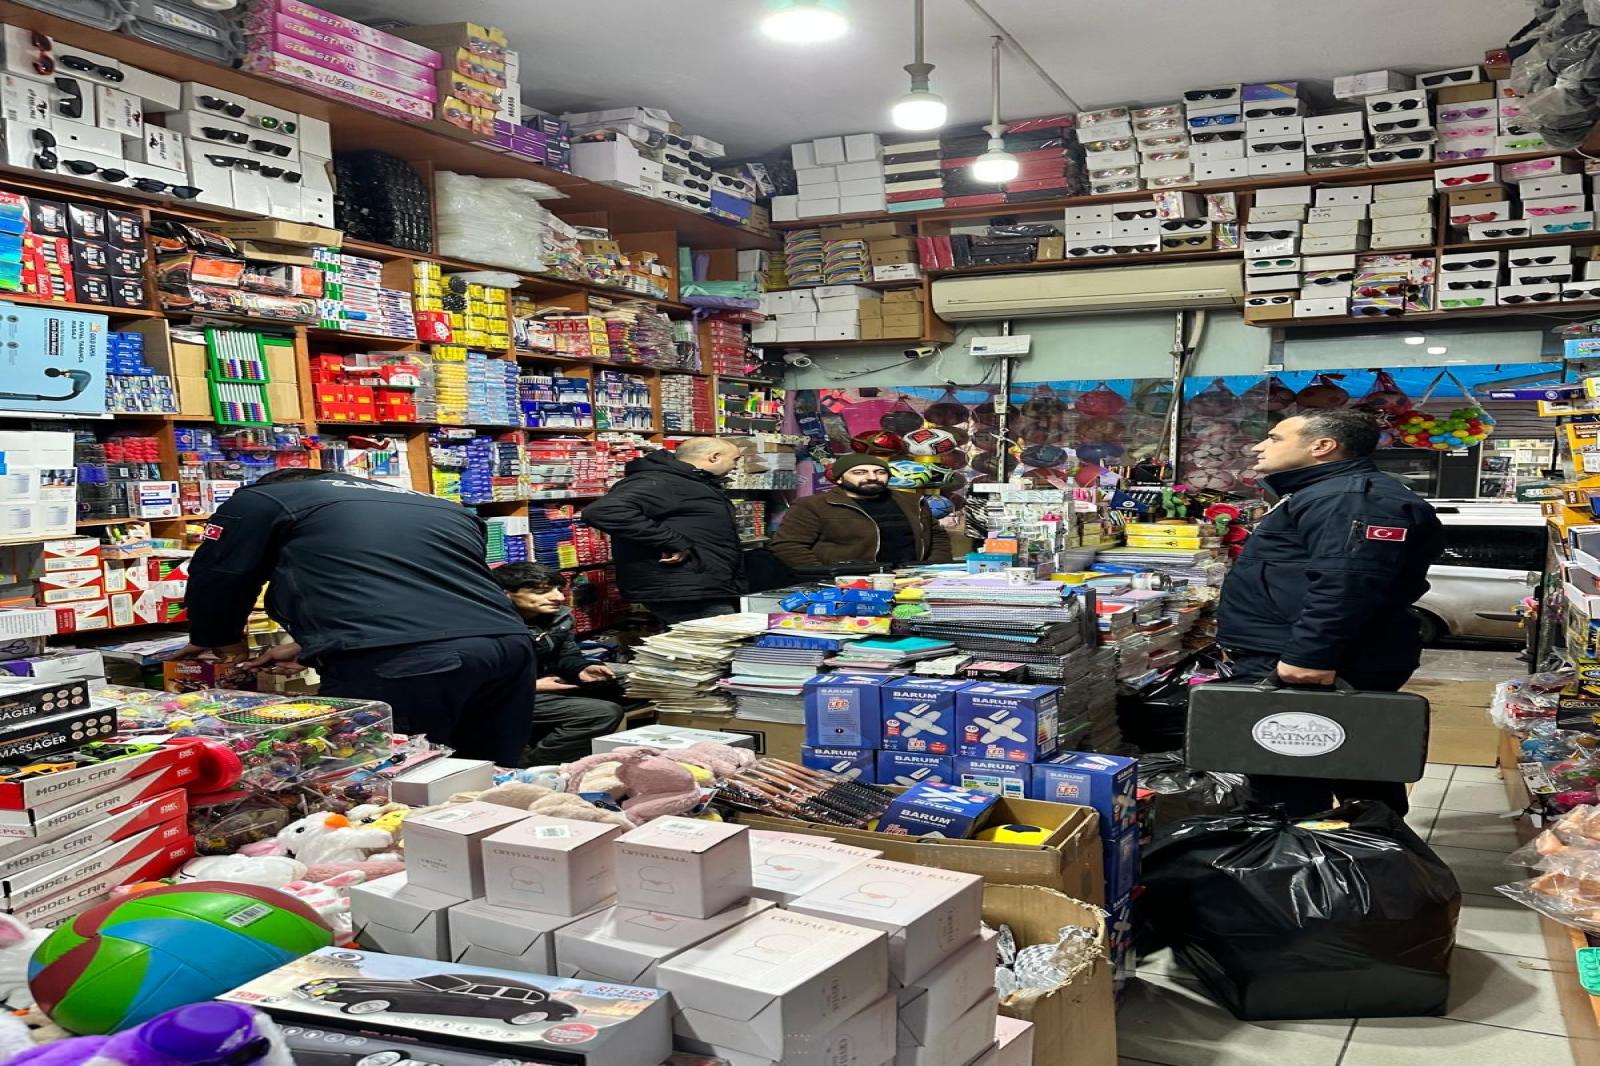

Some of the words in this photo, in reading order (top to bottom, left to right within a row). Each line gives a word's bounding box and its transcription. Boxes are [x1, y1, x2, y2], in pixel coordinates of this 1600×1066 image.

[893, 691, 937, 699] BARUM
[972, 697, 1018, 706] BARUM
[0, 705, 37, 721] AGER
[1262, 731, 1336, 743] BATMAN
[0, 735, 67, 758] MASSAGER
[814, 749, 858, 757] BARUM
[895, 756, 940, 764] BARUM
[970, 761, 1016, 771] BARUM
[36, 777, 85, 797] MODEL
[88, 766, 117, 782] CAR
[49, 808, 93, 828] MODEL
[95, 795, 121, 810] CAR
[900, 809, 952, 825] BARUM
[6, 847, 60, 871] MODEL
[63, 834, 94, 850] CAR
[24, 875, 72, 898] MODEL
[75, 861, 103, 877] CAR
[25, 896, 76, 919] MODEL
[78, 882, 107, 898] CAR
